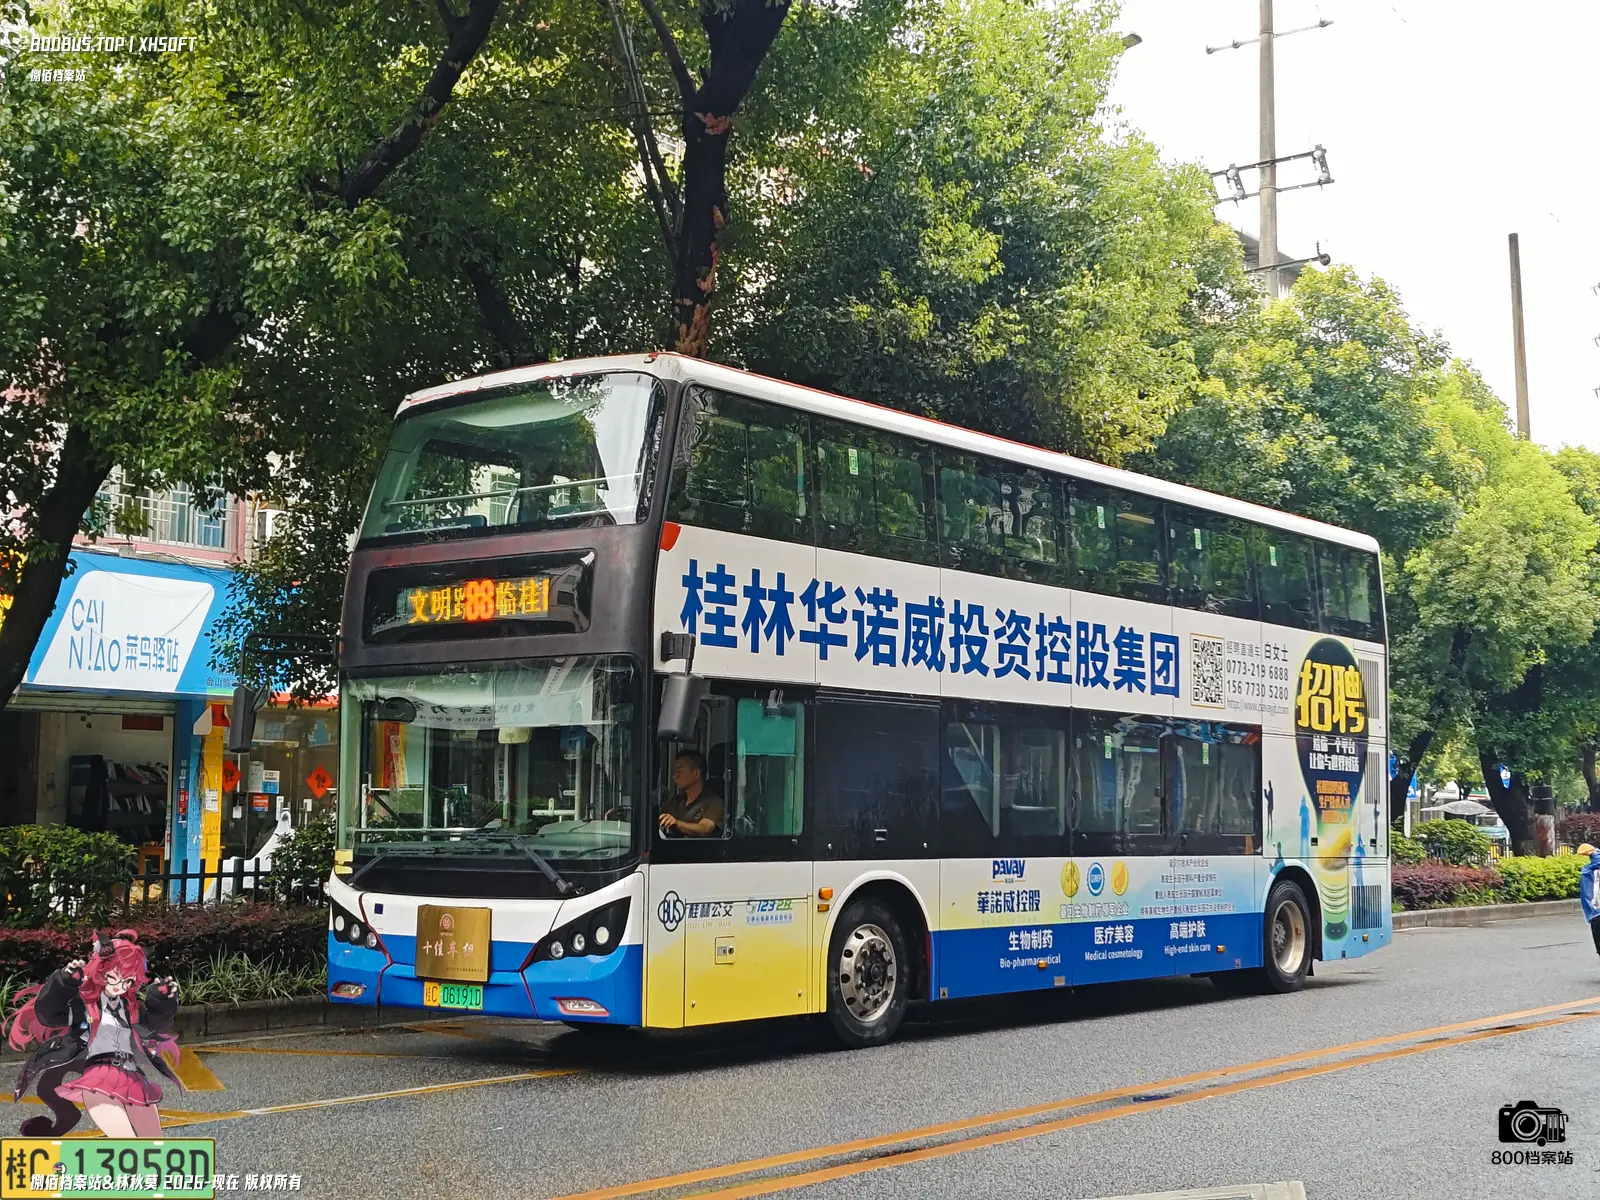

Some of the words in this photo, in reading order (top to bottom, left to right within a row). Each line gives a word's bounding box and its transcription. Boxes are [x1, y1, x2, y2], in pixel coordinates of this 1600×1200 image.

[465, 578, 495, 622] 88
[496, 577, 550, 616] 临桂
[71, 598, 104, 634] CAI
[680, 558, 1180, 698] 桂林华诺威投资控股集团
[125, 634, 179, 673] 菜鸟驿站
[1264, 641, 1289, 662] 白女士
[1226, 659, 1266, 678] 0773-219
[1268, 665, 1289, 681] 6888
[1227, 680, 1242, 694] 156
[1245, 681, 1266, 697] 7730
[1268, 685, 1289, 700] 5280
[1296, 659, 1365, 734] 招聘
[992, 859, 1026, 879] pavay
[688, 902, 733, 919] 桂林公交
[976, 889, 1041, 914] 華諾威控股
[1008, 929, 1053, 951] 生物制药
[1094, 925, 1135, 945] 医疗美容
[1169, 920, 1206, 940] 高端护肤
[1084, 950, 1107, 962] Medical
[1107, 948, 1144, 961] cosmetology
[1164, 945, 1188, 956] High-end
[1188, 944, 1200, 953] skin
[1200, 943, 1211, 952] care
[442, 986, 481, 1006] 06191D
